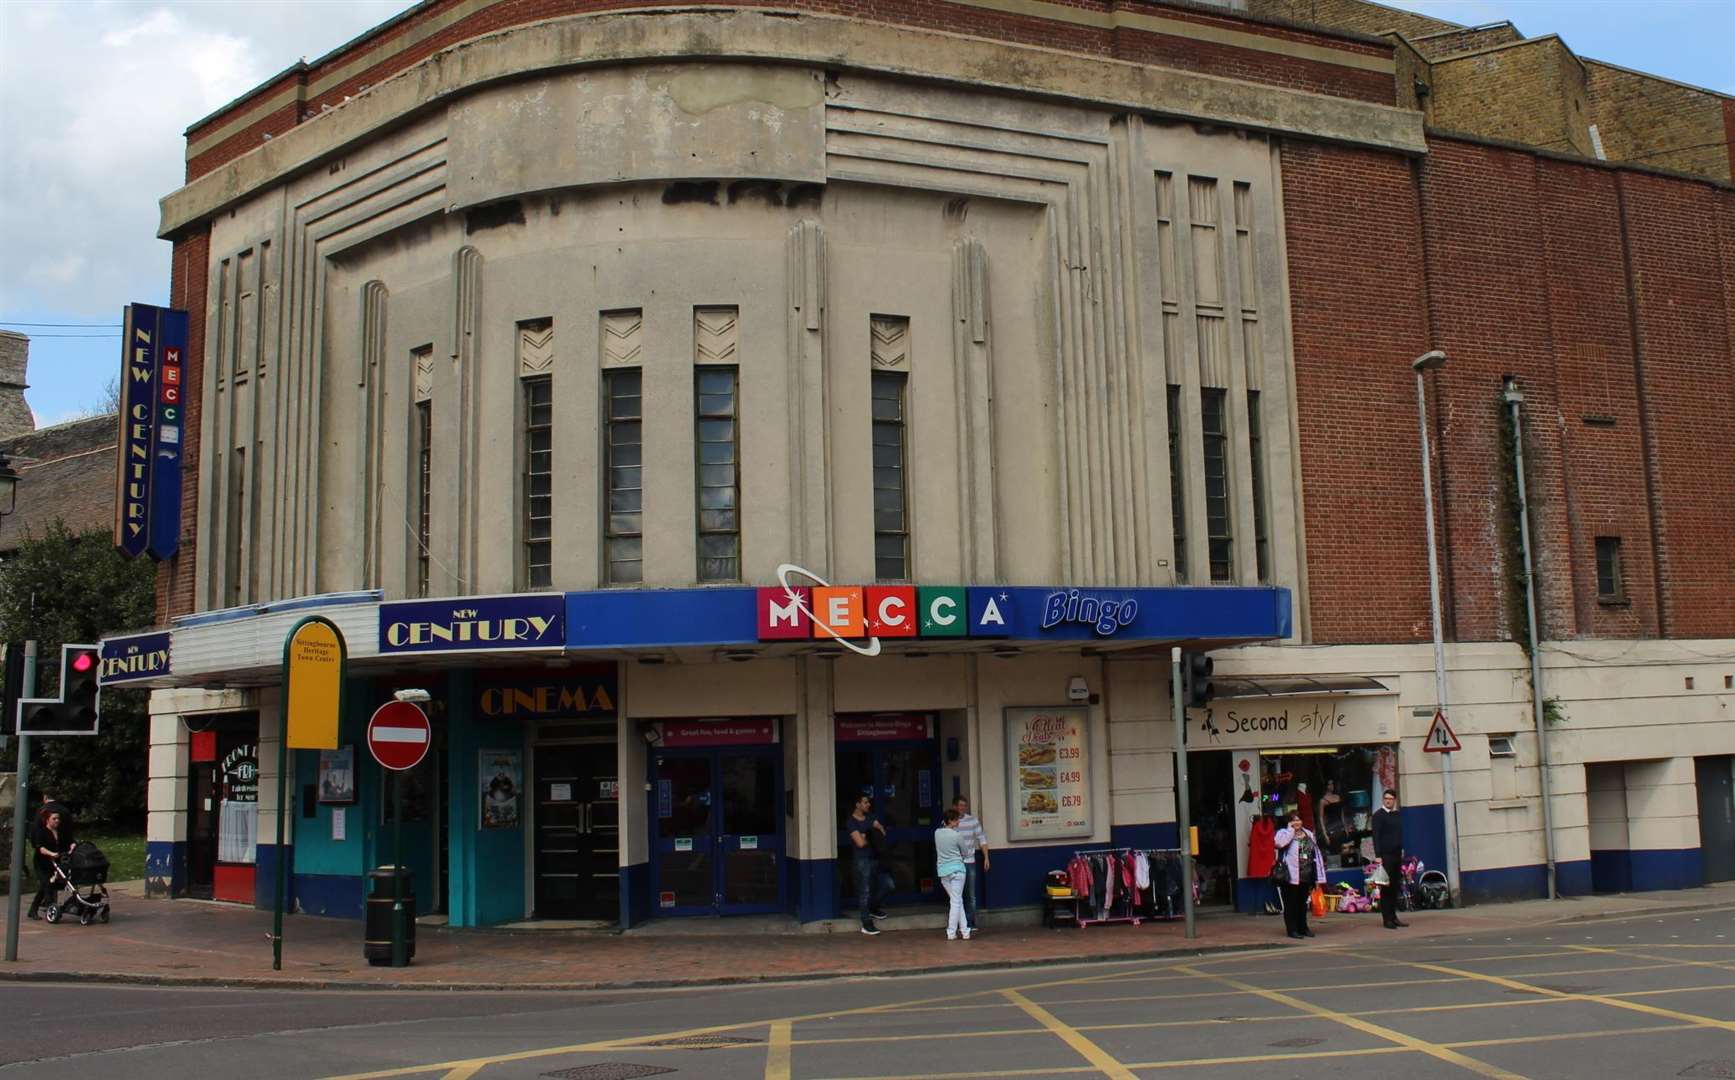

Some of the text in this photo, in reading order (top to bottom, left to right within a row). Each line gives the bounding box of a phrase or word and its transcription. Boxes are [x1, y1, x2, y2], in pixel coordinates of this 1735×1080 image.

[129, 327, 153, 538] NEW CENTURY
[452, 609, 478, 619] NEW
[769, 589, 1138, 635] MECCA Bingo
[387, 615, 556, 647] CENTURY
[99, 649, 170, 678] CENTURY
[480, 684, 615, 716] CINEMA
[1225, 709, 1288, 734] Second
[1299, 703, 1347, 738] style
[222, 744, 249, 773] FRONT
[1059, 747, 1080, 759] £3.99
[1060, 772, 1081, 784] £4.99
